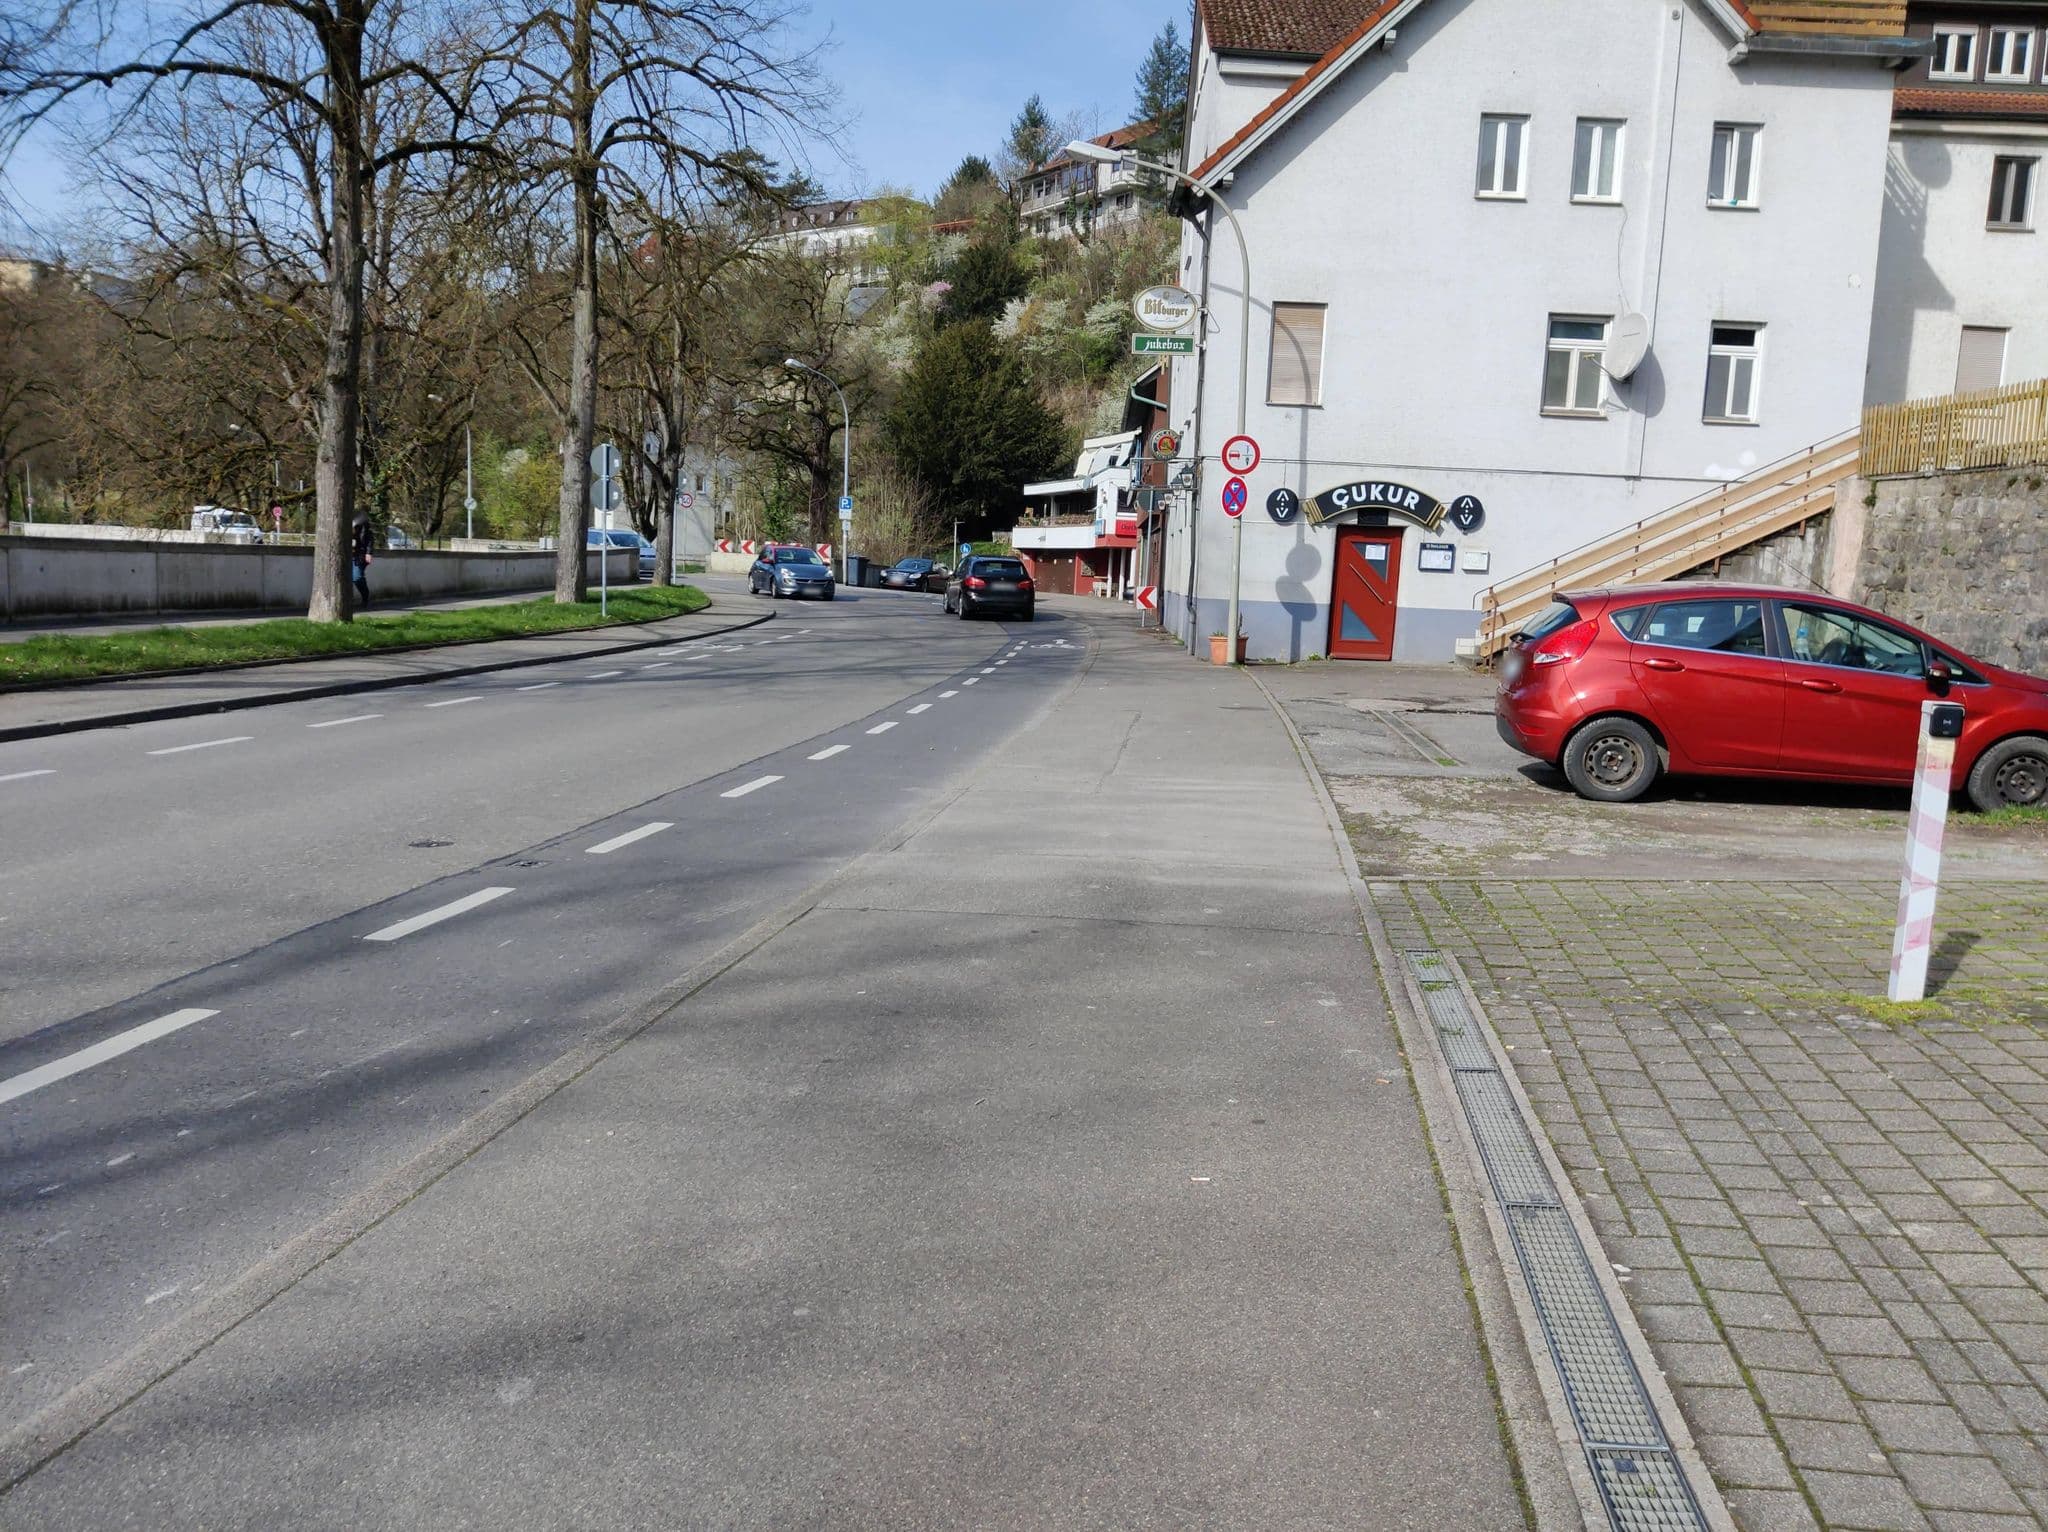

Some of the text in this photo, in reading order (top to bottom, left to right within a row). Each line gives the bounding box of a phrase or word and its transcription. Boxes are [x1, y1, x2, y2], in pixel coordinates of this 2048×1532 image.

[1144, 298, 1188, 317] Bitburger
[1143, 338, 1185, 352] jukebox
[841, 498, 849, 508] P
[1332, 484, 1420, 510] ÇUKUR
